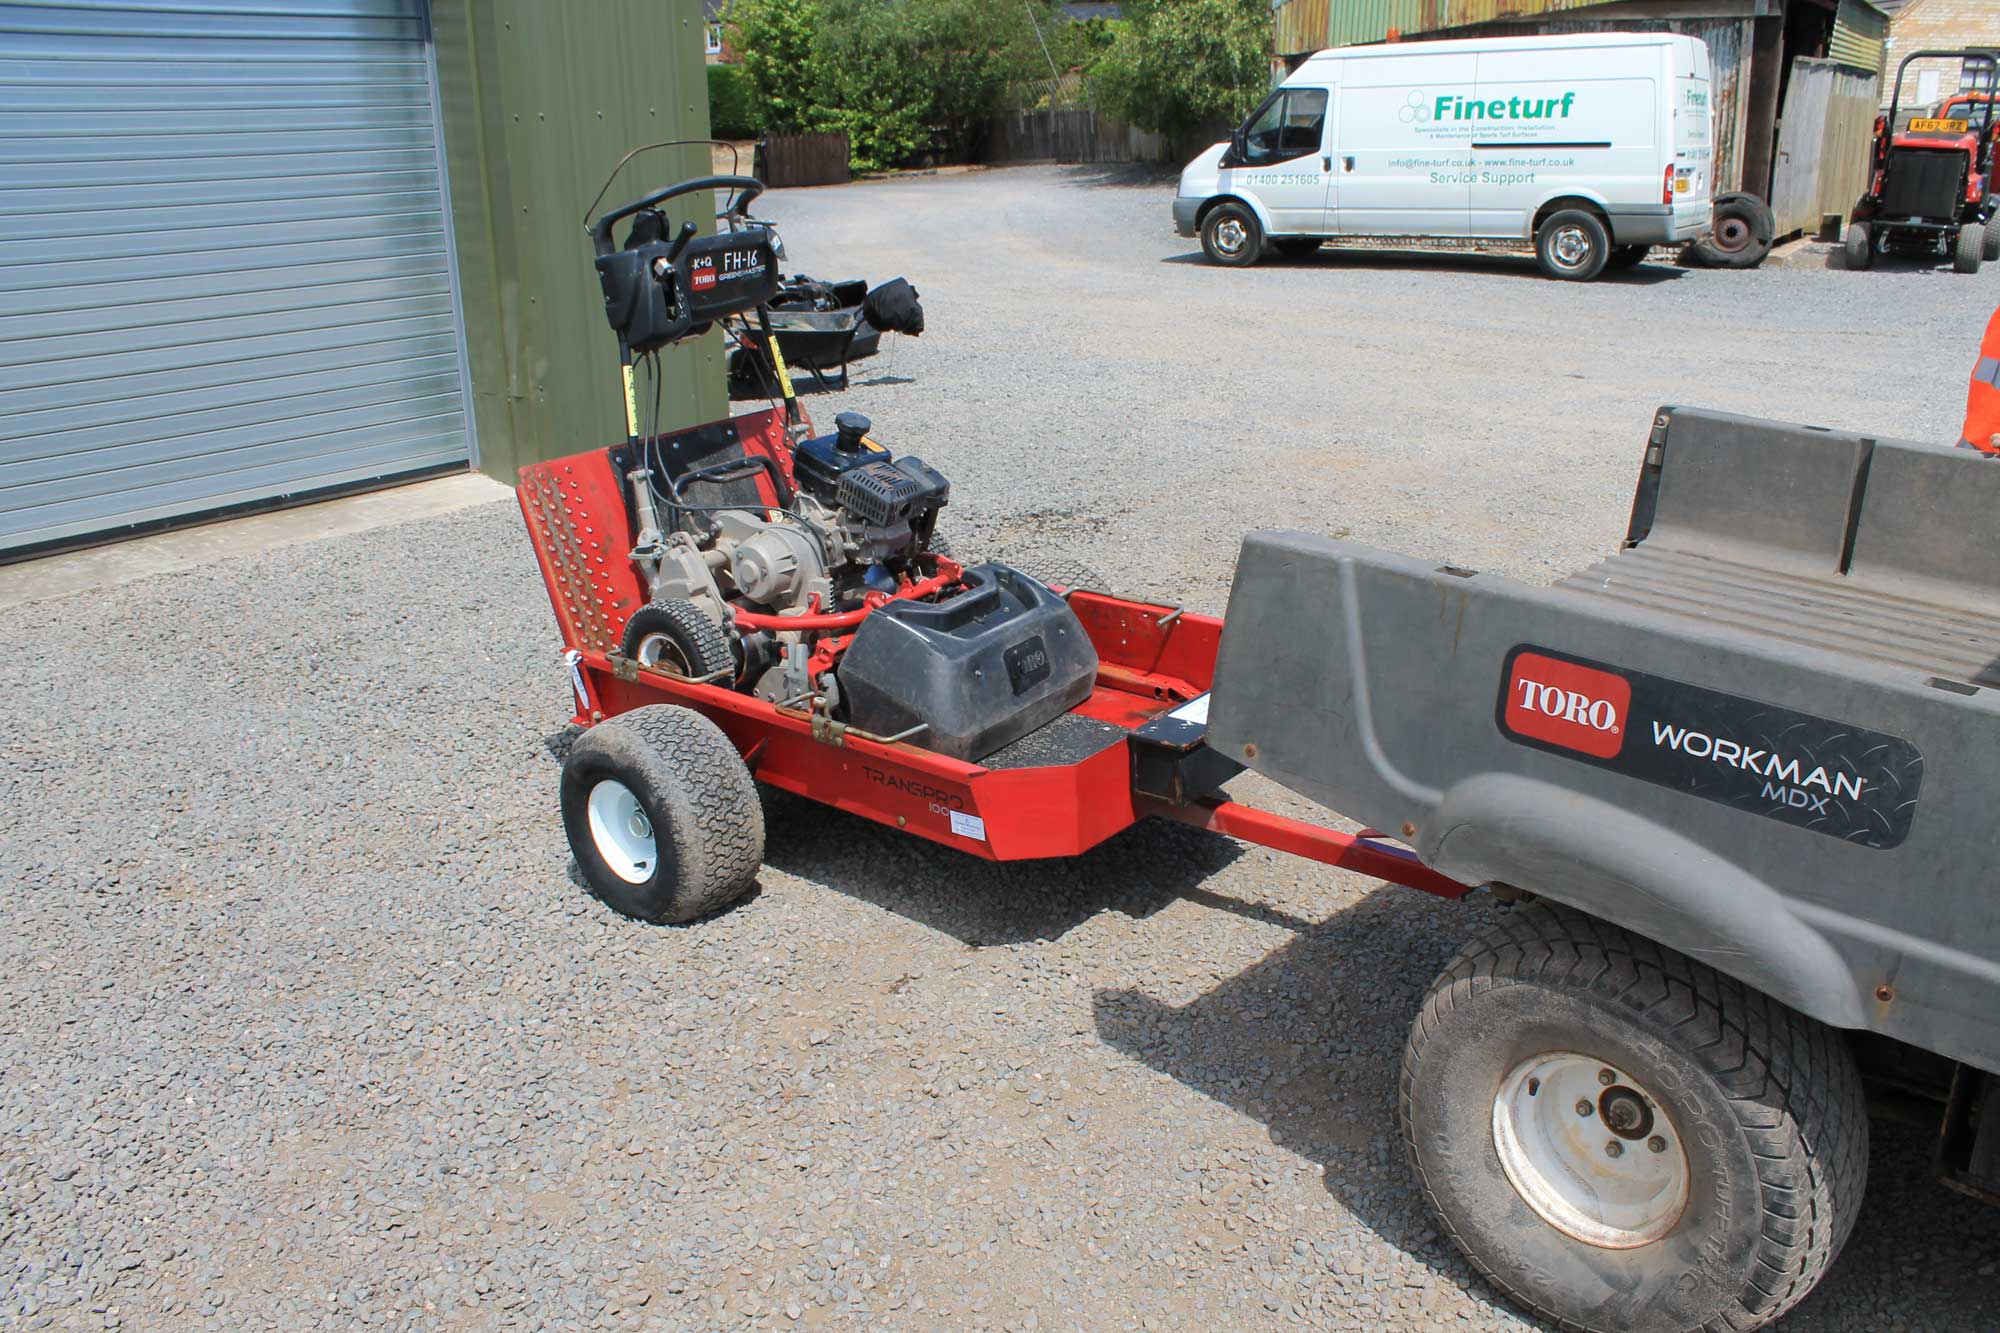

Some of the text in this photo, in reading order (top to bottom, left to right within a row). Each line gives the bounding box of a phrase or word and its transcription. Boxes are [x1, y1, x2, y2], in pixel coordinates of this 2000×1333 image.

[1434, 92, 1576, 121] Fineturf
[1484, 158, 1575, 167] www.fine-turf.co.uk
[1246, 174, 1320, 185] 01400 251605
[1430, 171, 1535, 186] Service Support
[724, 250, 758, 272] FH-16
[694, 275, 716, 285] TORO
[1518, 678, 1617, 731] TORO
[1652, 720, 1864, 800] WORKMAN
[863, 765, 965, 810] TRANSPRO
[1761, 781, 1831, 815] MDX
